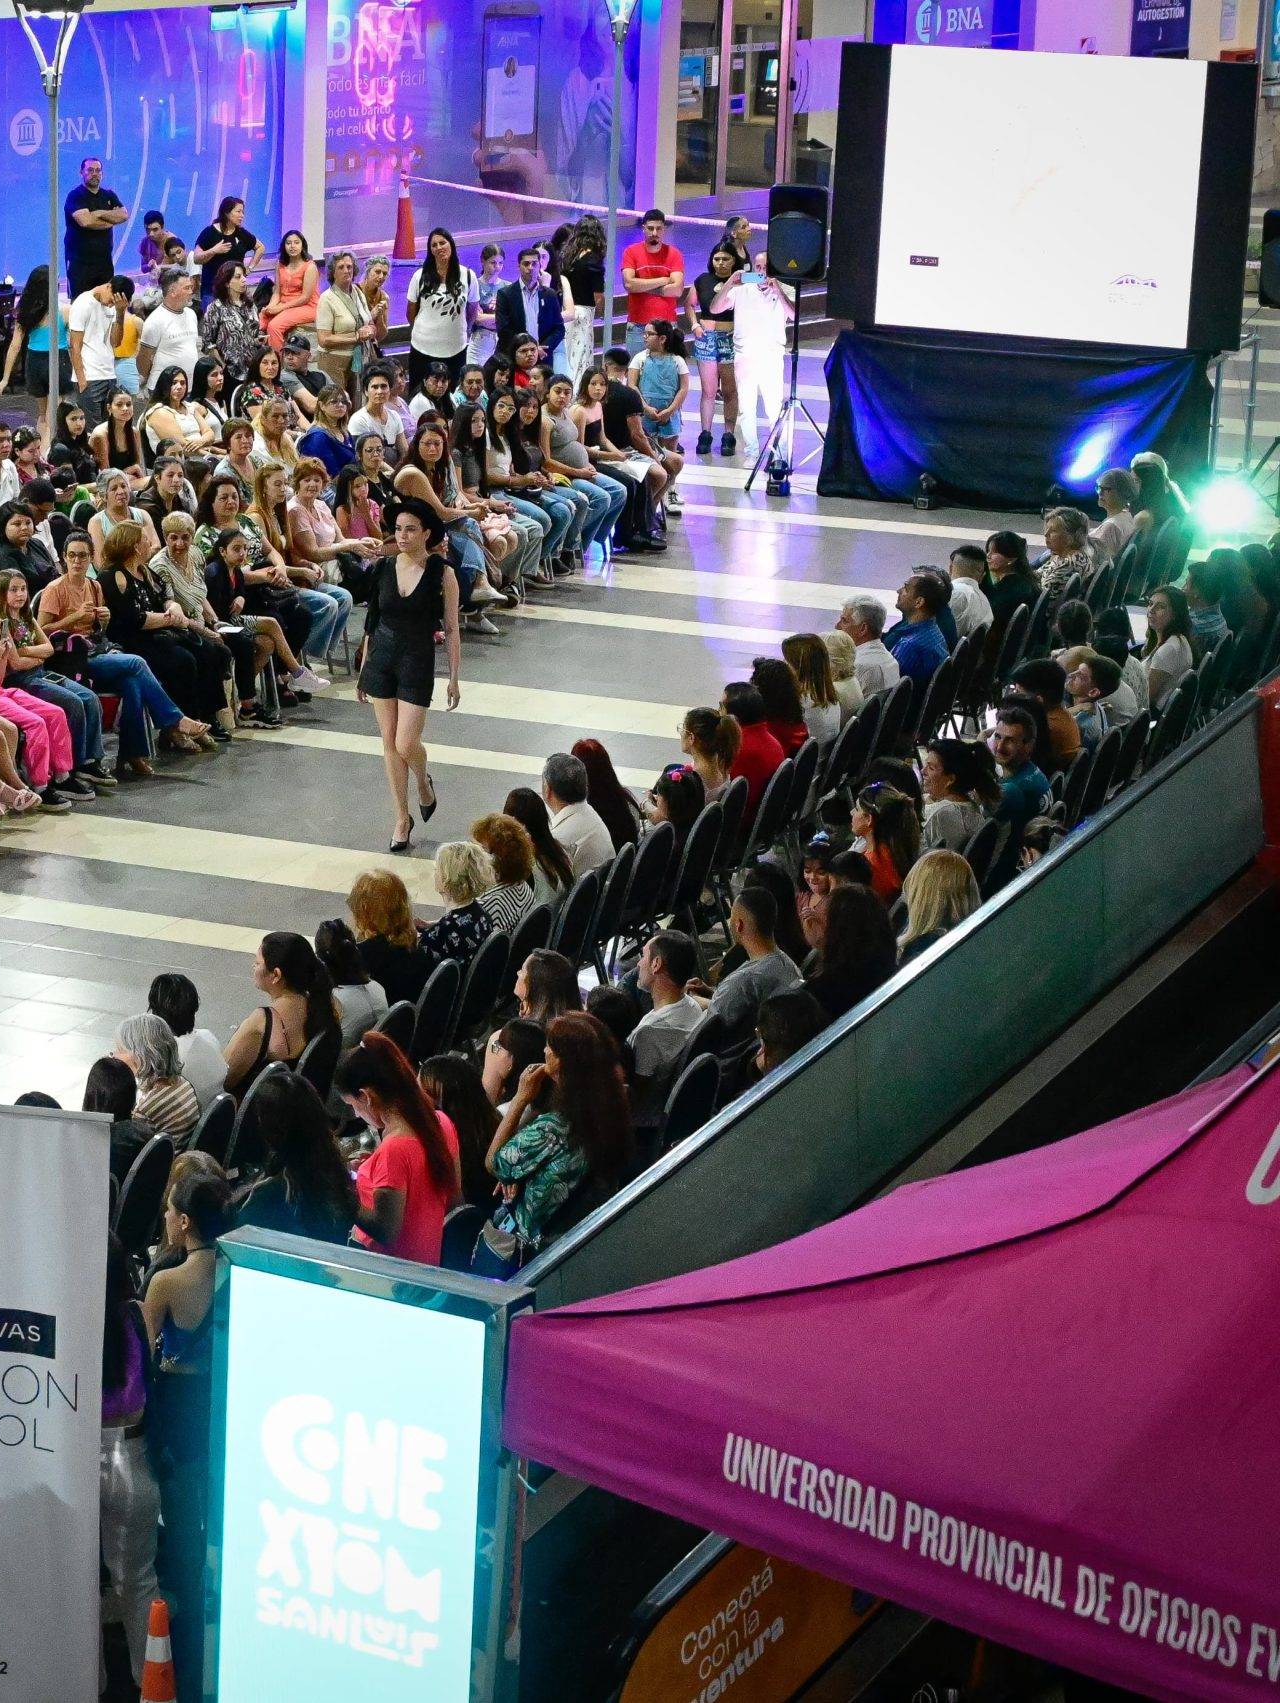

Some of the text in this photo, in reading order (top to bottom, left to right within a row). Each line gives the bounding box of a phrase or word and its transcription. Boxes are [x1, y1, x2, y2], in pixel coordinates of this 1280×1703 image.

[945, 6, 984, 32] BNA
[723, 1432, 898, 1543] UNIVERSIDAD
[902, 1501, 1066, 1610] PROVINCIAL
[1074, 1565, 1115, 1625] DE
[1119, 1581, 1242, 1668] OFICIOS
[681, 1557, 774, 1665] Conectá
[699, 1609, 760, 1680] con la
